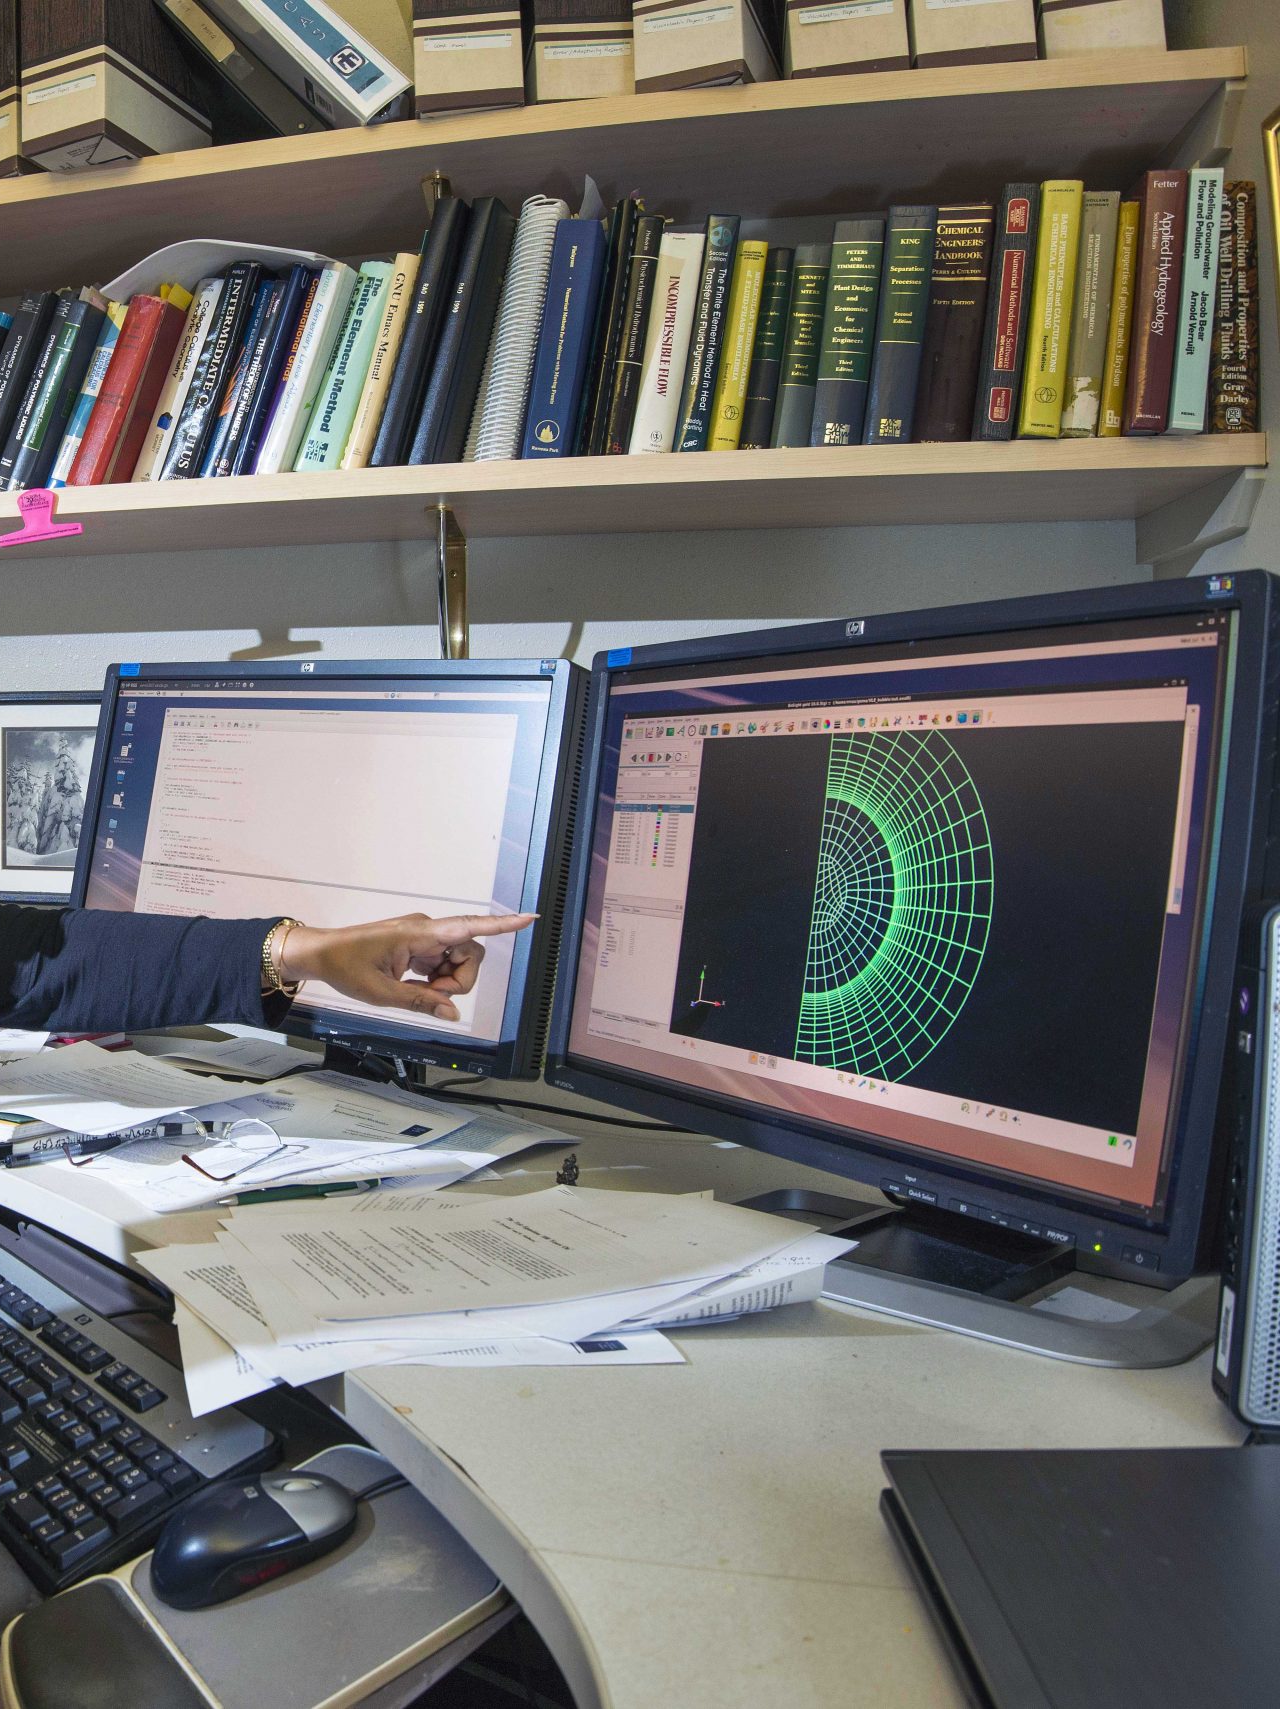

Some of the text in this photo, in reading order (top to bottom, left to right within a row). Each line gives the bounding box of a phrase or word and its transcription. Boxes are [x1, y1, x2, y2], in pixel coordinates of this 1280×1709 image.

[1153, 180, 1178, 188] Fetter
[936, 225, 984, 235] CHEMICAL
[1060, 213, 1069, 239] BASIC
[1152, 211, 1160, 231] Second
[1193, 179, 1207, 260] Flow and Pollution
[1201, 179, 1217, 280] Modeling Groundwater
[320, 271, 334, 297] Anton
[371, 277, 383, 297] The
[420, 282, 429, 294] RAO
[852, 285, 873, 293] Design
[1010, 252, 1021, 288] Numerical
[1044, 222, 1059, 329] CHEMICAL ENGINEERING
[1056, 240, 1066, 291] PRINCIPLES
[1083, 234, 1094, 319] REACTION ENGINEERING
[1088, 234, 1100, 338] FUNDAMENTALS CHEMICAL
[1151, 211, 1175, 336] Applied Hydrogeology
[1218, 211, 1234, 360] Oil Well Drilling Fluids
[1234, 192, 1250, 361] Composition and Properties
[172, 300, 201, 378] Analytic Geometry
[182, 300, 210, 371] College Calculus
[282, 278, 320, 382] Computational Grids
[302, 302, 324, 351] Elementary
[328, 299, 357, 372] Zienkiewicz
[371, 272, 406, 381] GNU Emacs Manual
[628, 260, 649, 358] Physicochemical Hydrodynamics
[656, 275, 681, 397] INCOMPRESSIBLE FLOW
[690, 267, 715, 385] Transfer and Fluid Dynamics
[699, 268, 727, 411] The Finite Element Method in Heat
[1007, 290, 1017, 322] Methods
[1111, 226, 1135, 387] Flow properties of polymer melts Brydson
[1185, 291, 1199, 356] Arnold Verruijt
[1197, 291, 1210, 342] Jacob Bear
[4, 370, 11, 379] OF
[6, 336, 22, 369] DYNAMICS
[178, 279, 242, 469] INTERMEDIATE CALCULUS
[319, 276, 375, 433] Finite Element Method
[738, 322, 754, 398] THERMODYNAMICS
[1004, 337, 1013, 369] Software
[1049, 308, 1062, 373] CALCULATIONS
[15, 334, 56, 440] DYNAMICS OF POLYMERIC LIQUIDS
[229, 338, 266, 441] THE THEORY NUMBERS
[1219, 394, 1250, 405] Darley
[1220, 372, 1248, 381] Edition
[1222, 383, 1246, 392] Gray
[683, 439, 698, 448] CRC
[909, 1189, 921, 1199] Quick
[921, 1193, 935, 1202] Select
